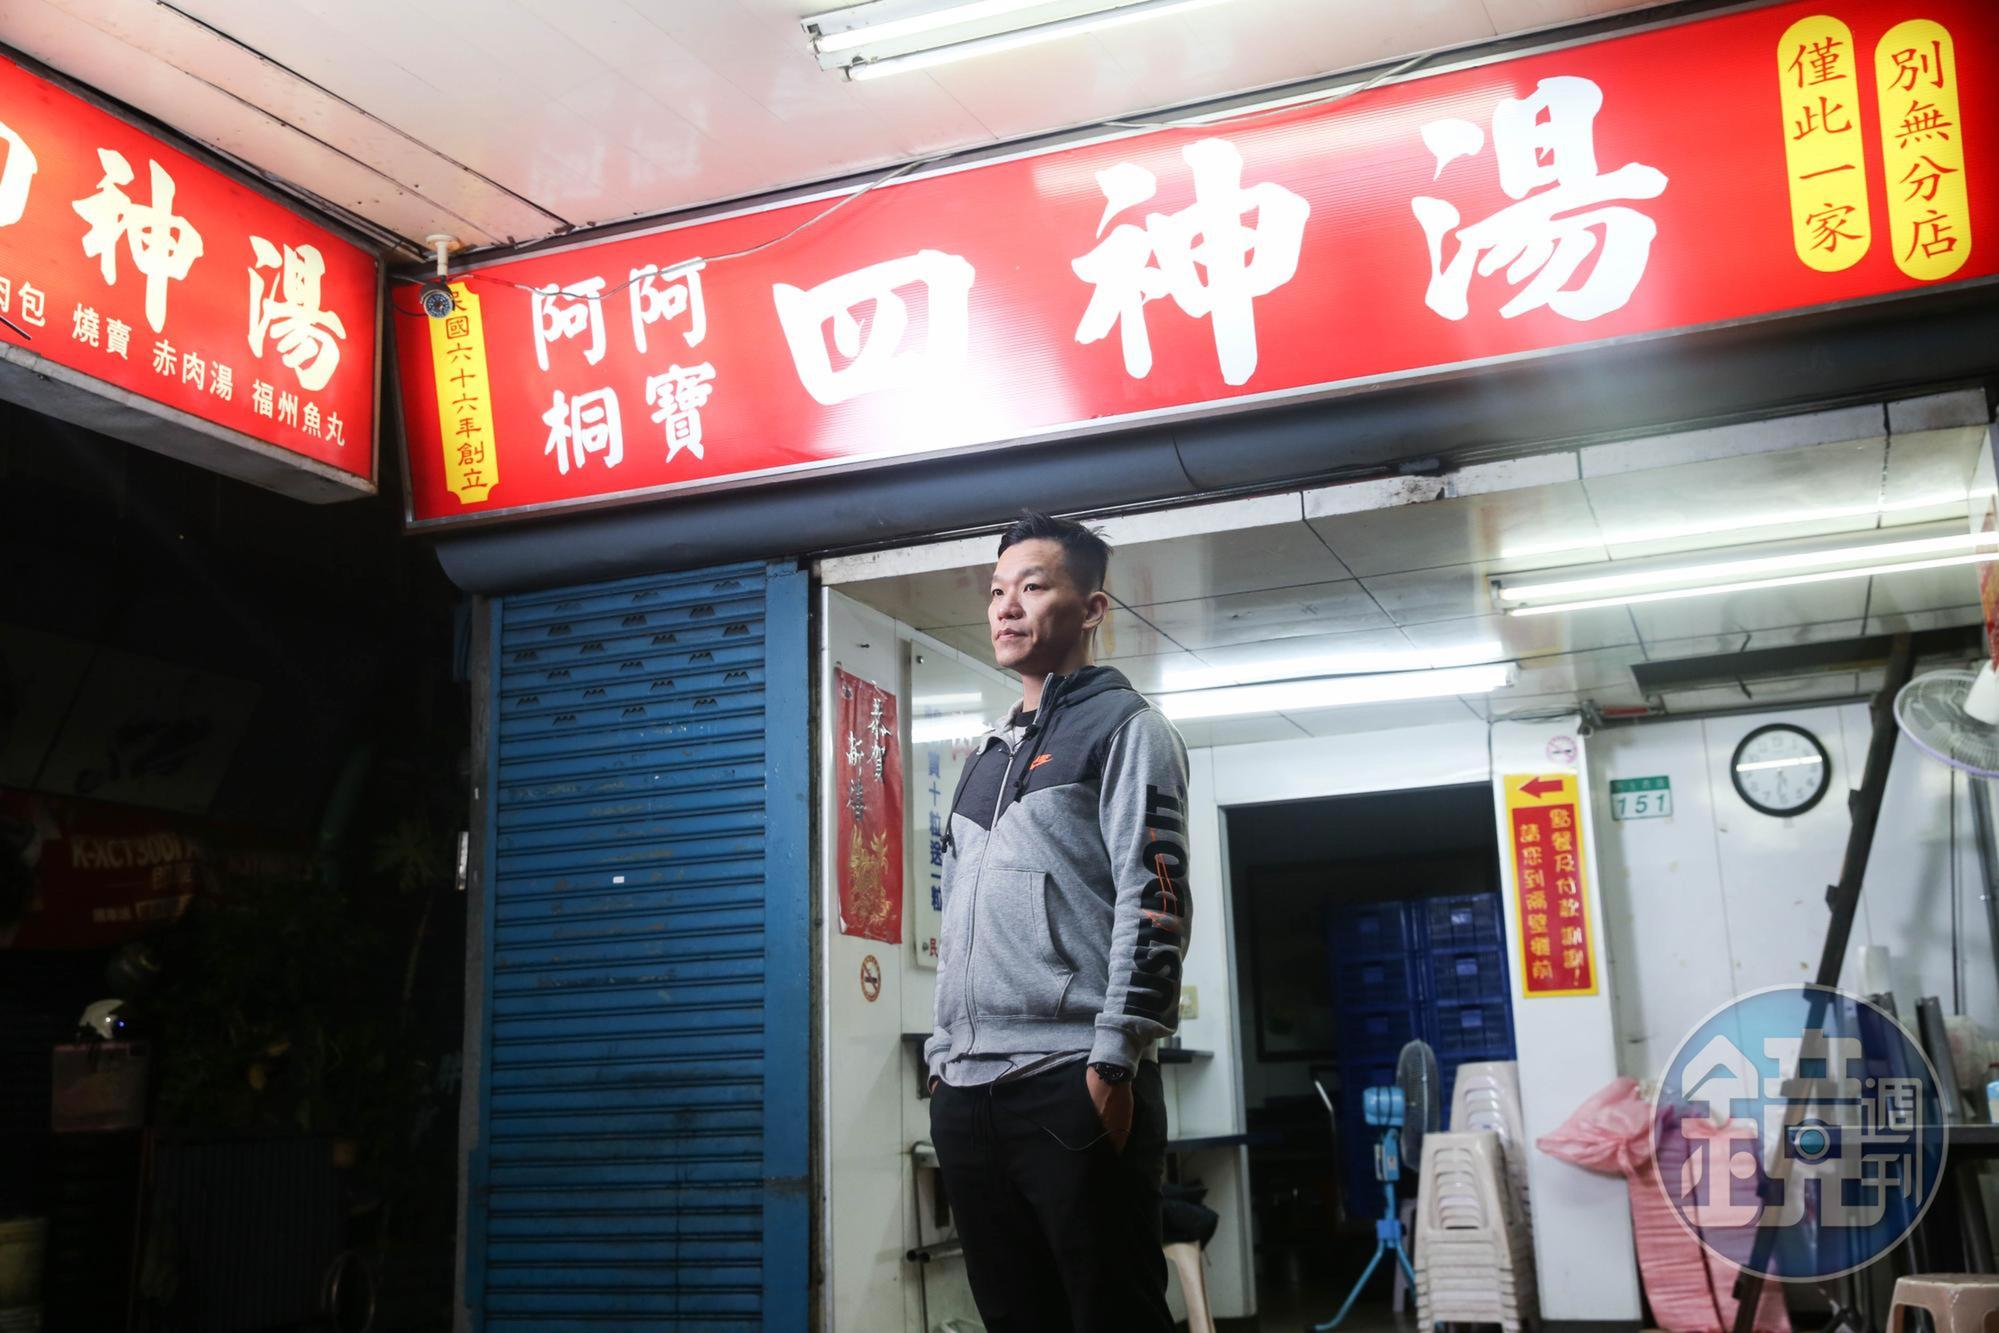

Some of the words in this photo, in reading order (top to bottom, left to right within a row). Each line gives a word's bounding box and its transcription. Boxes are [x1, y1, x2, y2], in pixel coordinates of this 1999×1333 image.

[774, 76, 1669, 406] 四神湯
[1788, 36, 1865, 253] 僅此一家
[1887, 40, 1959, 263] 別無分店
[71, 302, 132, 361] 燒賣
[152, 338, 233, 402] 赤肉湯
[251, 378, 346, 447] 福州魚丸
[1615, 793, 1665, 816] 151
